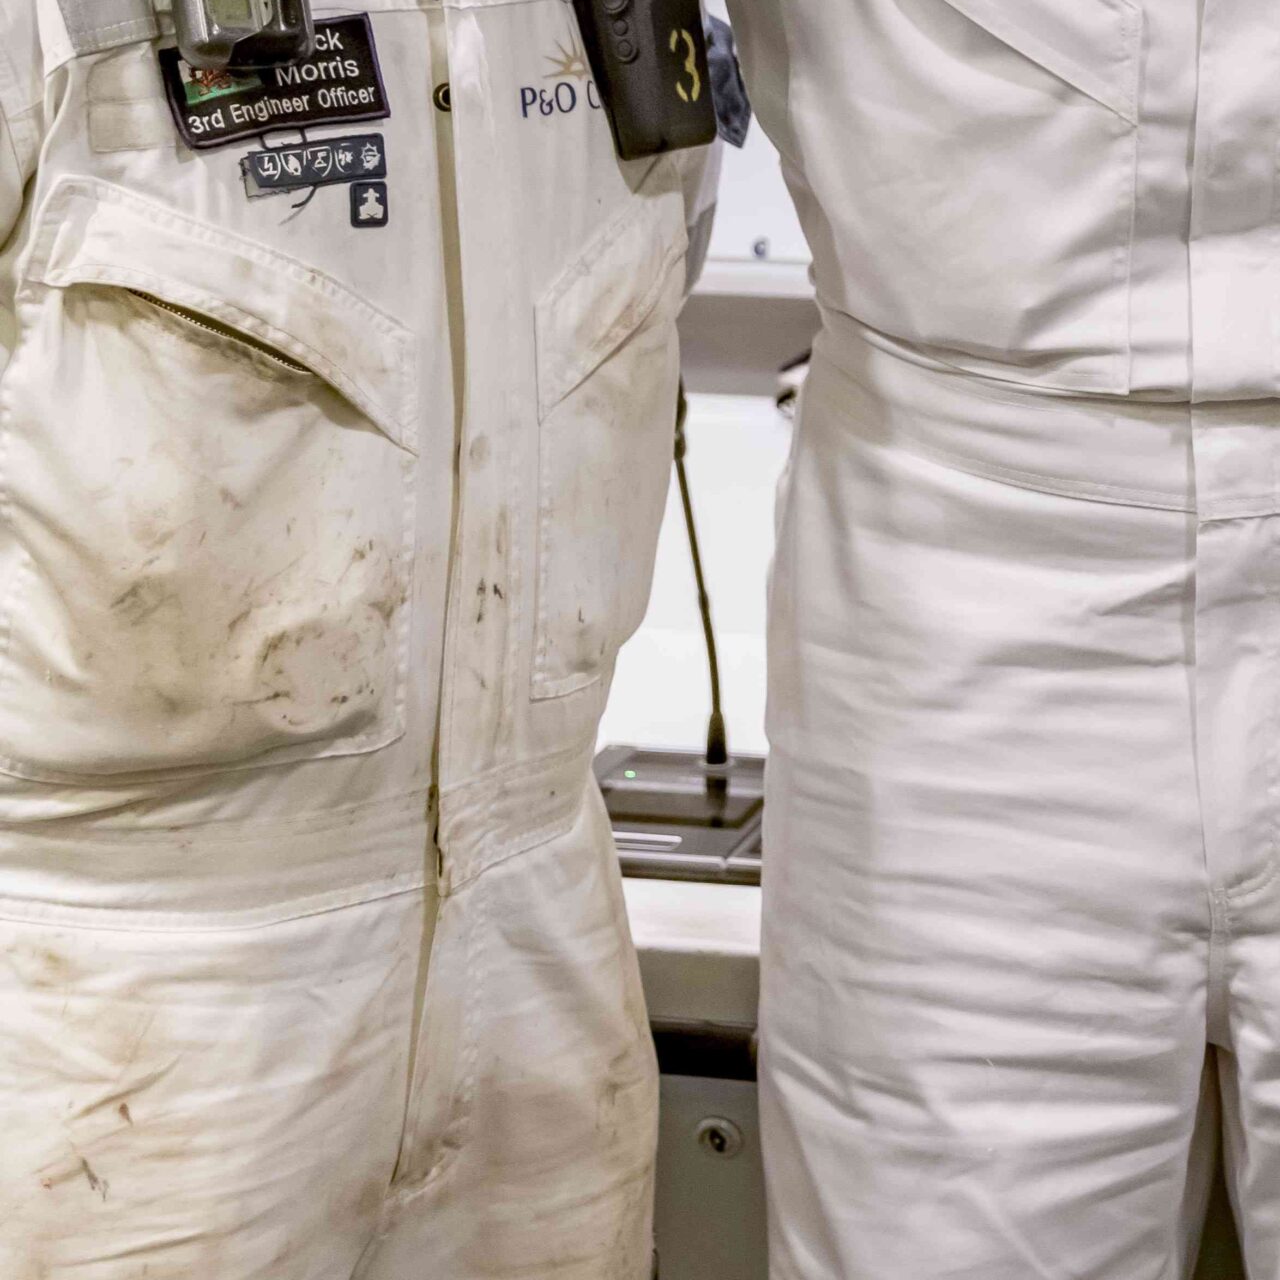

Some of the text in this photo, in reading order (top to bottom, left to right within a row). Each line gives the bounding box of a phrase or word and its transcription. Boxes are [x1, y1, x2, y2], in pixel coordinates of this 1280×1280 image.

[274, 56, 360, 87] Morris
[669, 28, 701, 103] 3
[188, 86, 375, 134] 3rd Engineer Officer
[520, 81, 577, 118] P&O
